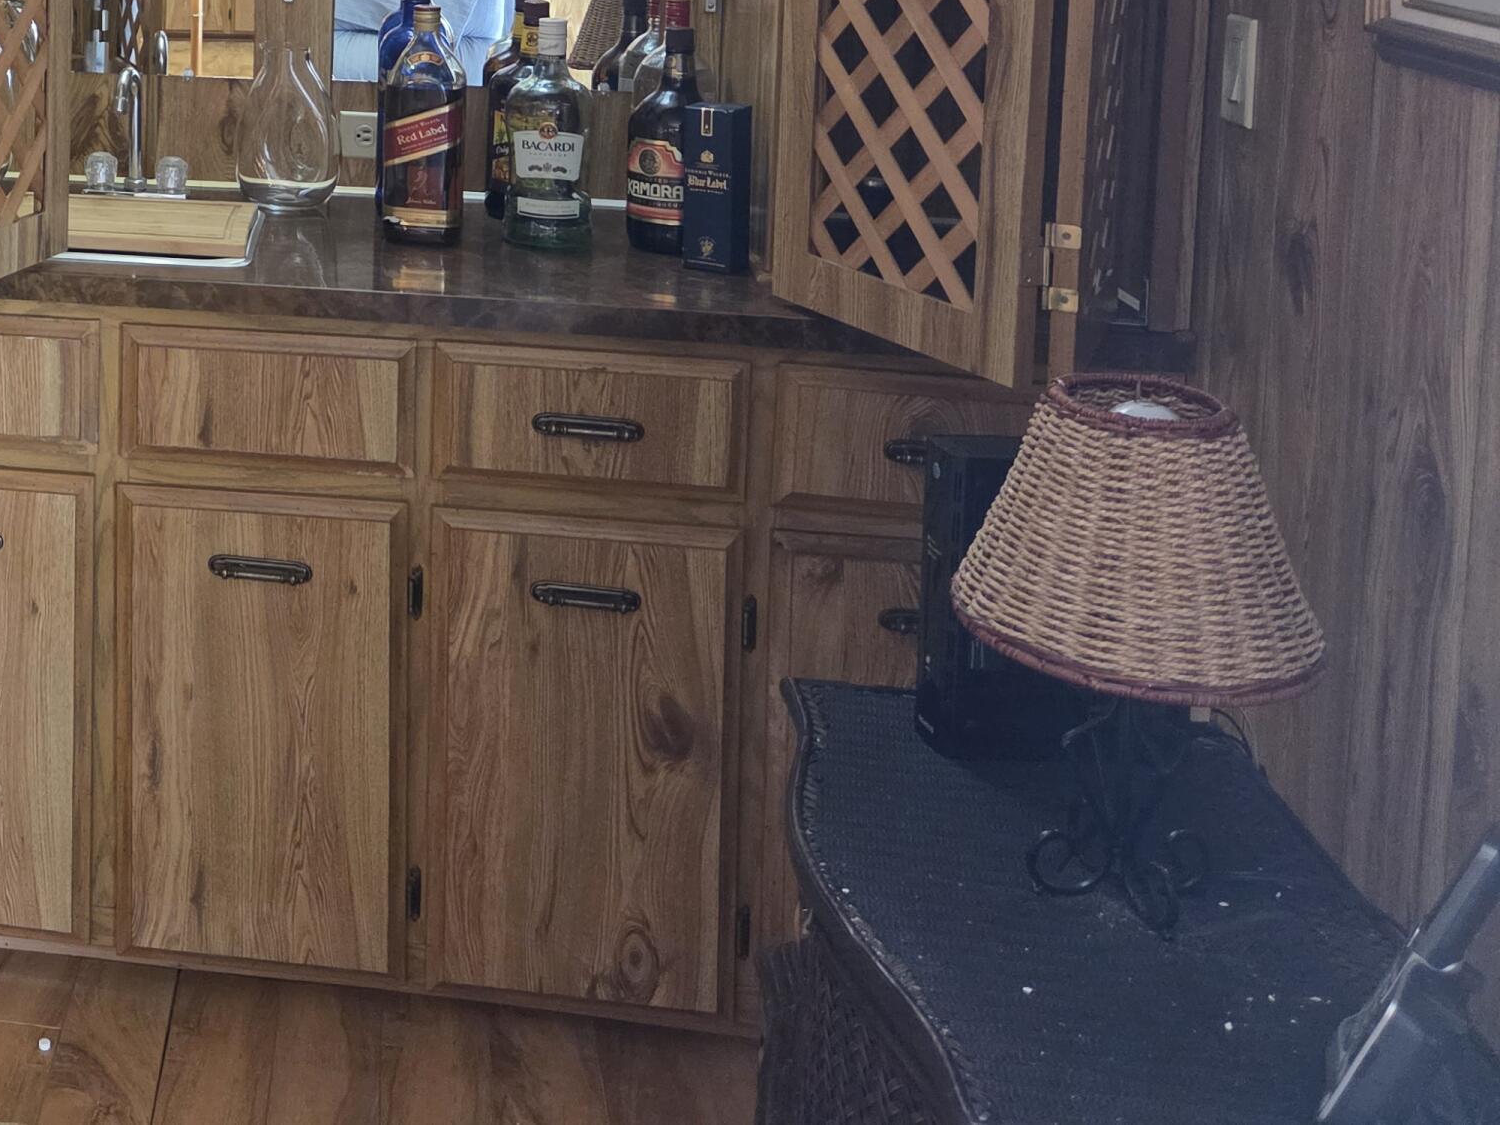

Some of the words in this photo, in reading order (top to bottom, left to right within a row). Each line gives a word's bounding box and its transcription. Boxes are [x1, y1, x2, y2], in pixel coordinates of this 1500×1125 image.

[396, 132, 418, 146] Red
[418, 123, 448, 140] Label
[521, 139, 575, 153] BACARDI
[627, 177, 685, 201] KAMORA
[706, 176, 728, 191] Label
